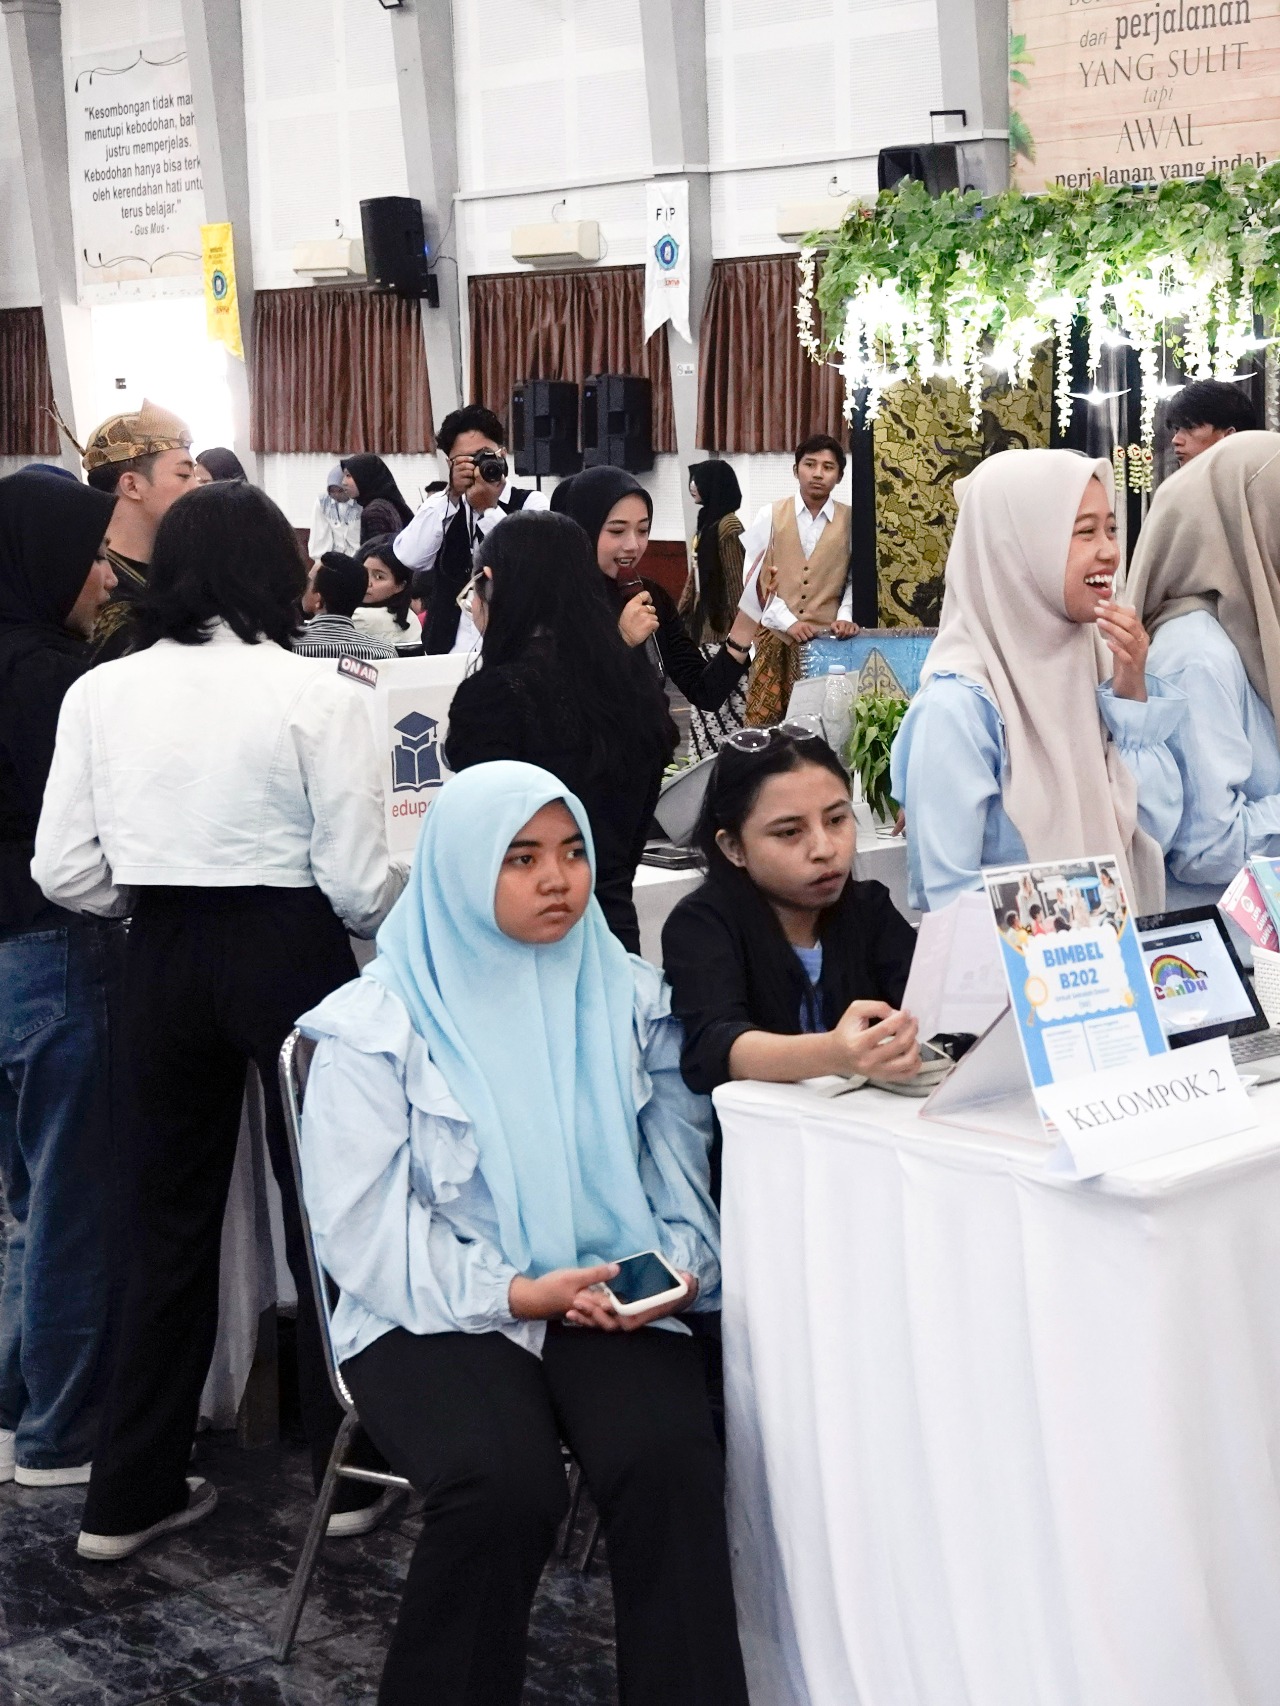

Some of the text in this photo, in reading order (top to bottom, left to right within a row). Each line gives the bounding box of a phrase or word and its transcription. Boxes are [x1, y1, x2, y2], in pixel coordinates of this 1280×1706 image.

[1079, 0, 1252, 50] dari perjalanan
[1079, 41, 1249, 88] YANG SULIT
[152, 94, 175, 111] tidak
[1142, 80, 1175, 109] tapi
[84, 122, 124, 141] menutupi
[125, 115, 178, 135] kebodohan,
[1116, 113, 1203, 154] AWAL
[105, 134, 192, 161] justru memperjelas.
[84, 166, 133, 183] Kebodohan
[134, 163, 161, 178] hanya
[163, 159, 182, 173] bisa
[92, 187, 111, 202] oleh
[112, 181, 164, 199] kerendahan
[165, 178, 183, 193] hati
[121, 206, 144, 219] terus
[134, 224, 149, 236] Gus
[150, 222, 165, 234] Mus
[341, 656, 377, 683] ON AIR
[1042, 941, 1104, 968] BIMBEL
[1059, 968, 1100, 990] B202
[1066, 1068, 1226, 1131] KELOMPOK 2
